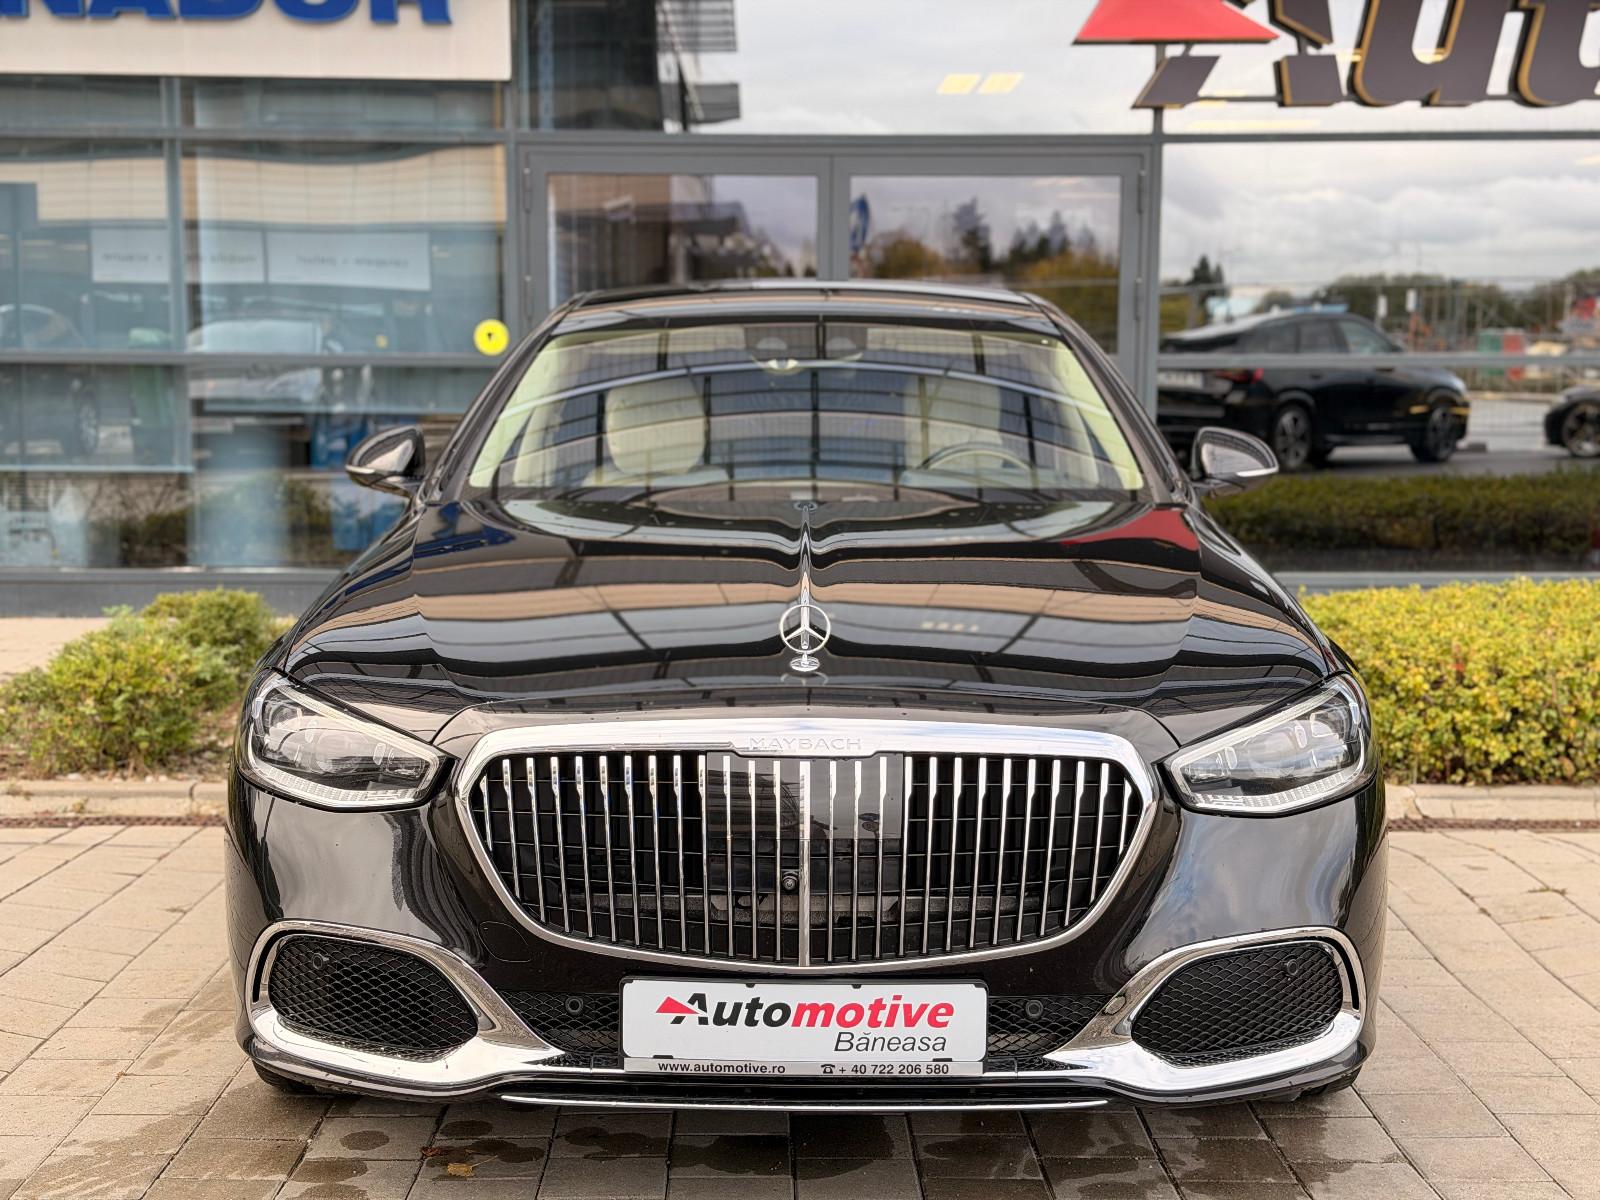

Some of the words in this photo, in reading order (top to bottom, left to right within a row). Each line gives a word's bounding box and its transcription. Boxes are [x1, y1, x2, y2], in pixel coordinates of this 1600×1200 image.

[750, 738, 861, 750] MAYBACH
[656, 993, 954, 1028] Automotive
[834, 1031, 947, 1052] Băneasa
[658, 1062, 786, 1074] www.automotive.ro
[851, 1064, 867, 1075] 40
[871, 1064, 894, 1075] 722
[898, 1064, 922, 1075] 206
[925, 1064, 949, 1075] 580
